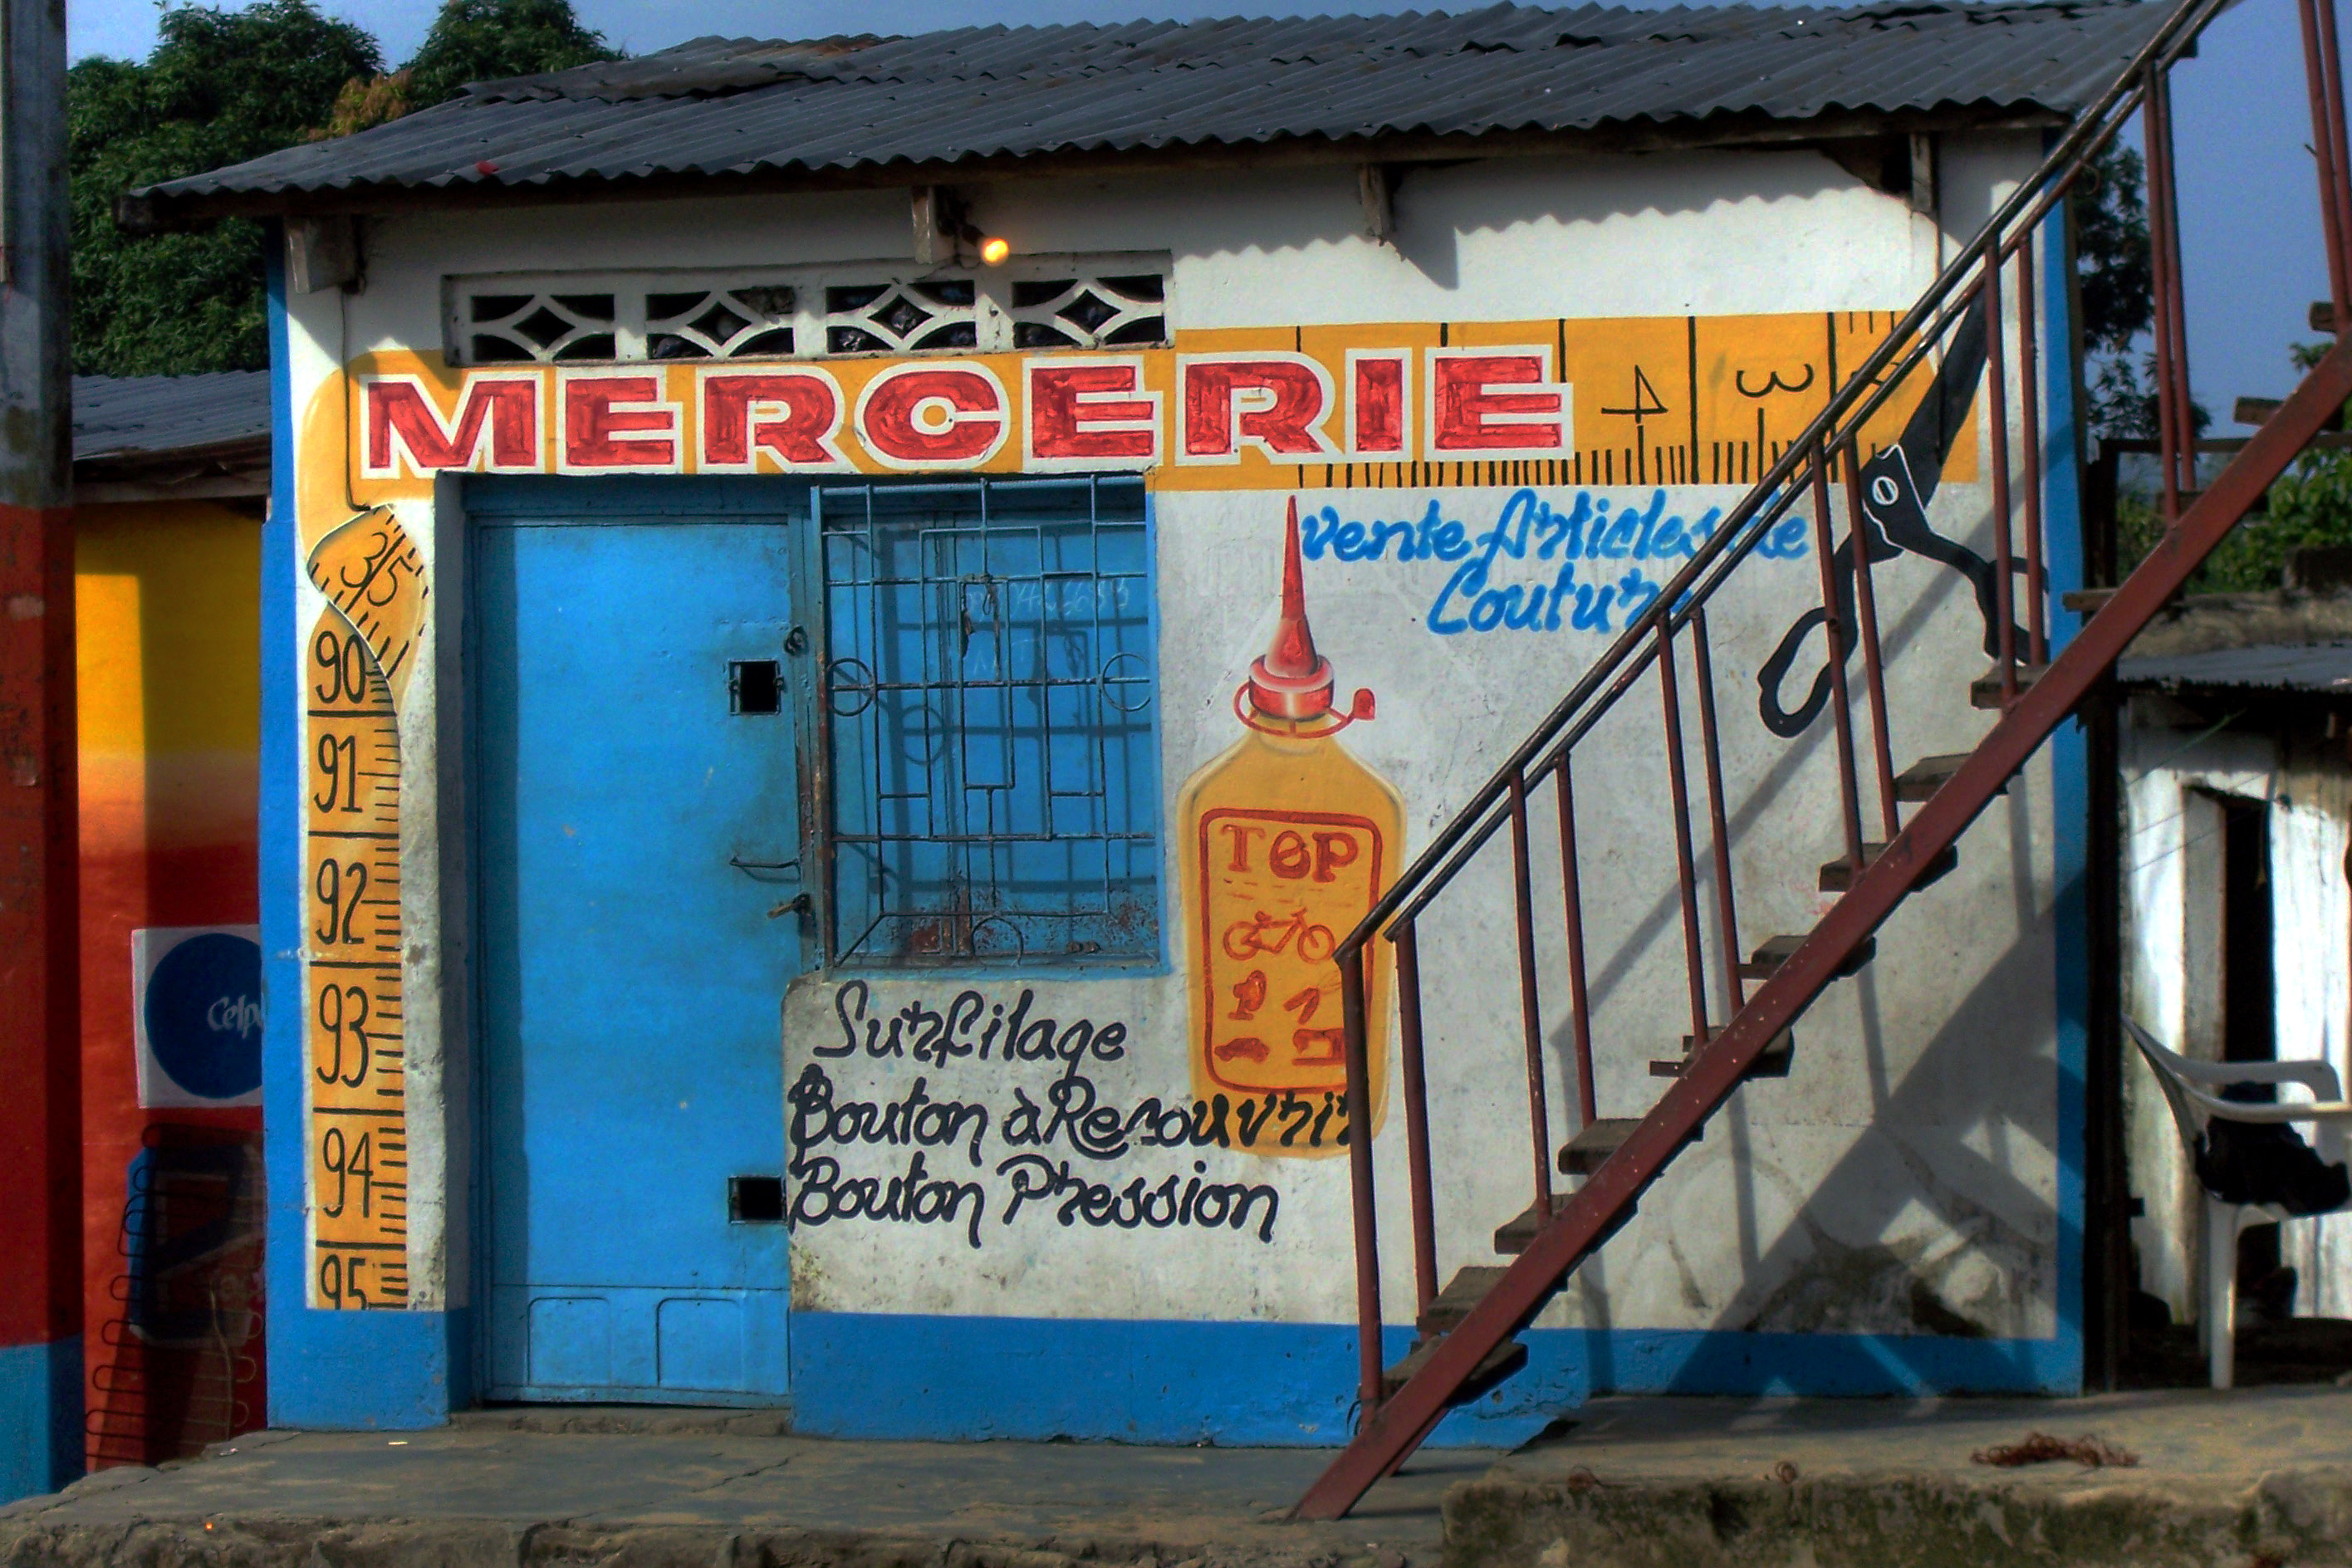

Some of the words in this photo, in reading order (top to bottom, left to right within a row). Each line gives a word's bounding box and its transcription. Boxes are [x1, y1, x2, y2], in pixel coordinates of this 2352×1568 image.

[360, 345, 1573, 478] MERCERIE
[316, 631, 366, 704] 90
[314, 733, 363, 813] 91
[1221, 824, 1360, 883] TOP
[316, 858, 368, 944] 92
[208, 994, 262, 1039] Celp
[316, 983, 369, 1089] 93
[812, 980, 1128, 1080] Surfilage
[787, 1064, 989, 1168] Bouton
[322, 1128, 374, 1218] 94
[789, 1151, 982, 1248] Bouton
[997, 1155, 1279, 1242] Pression
[321, 1254, 367, 1310] 95
